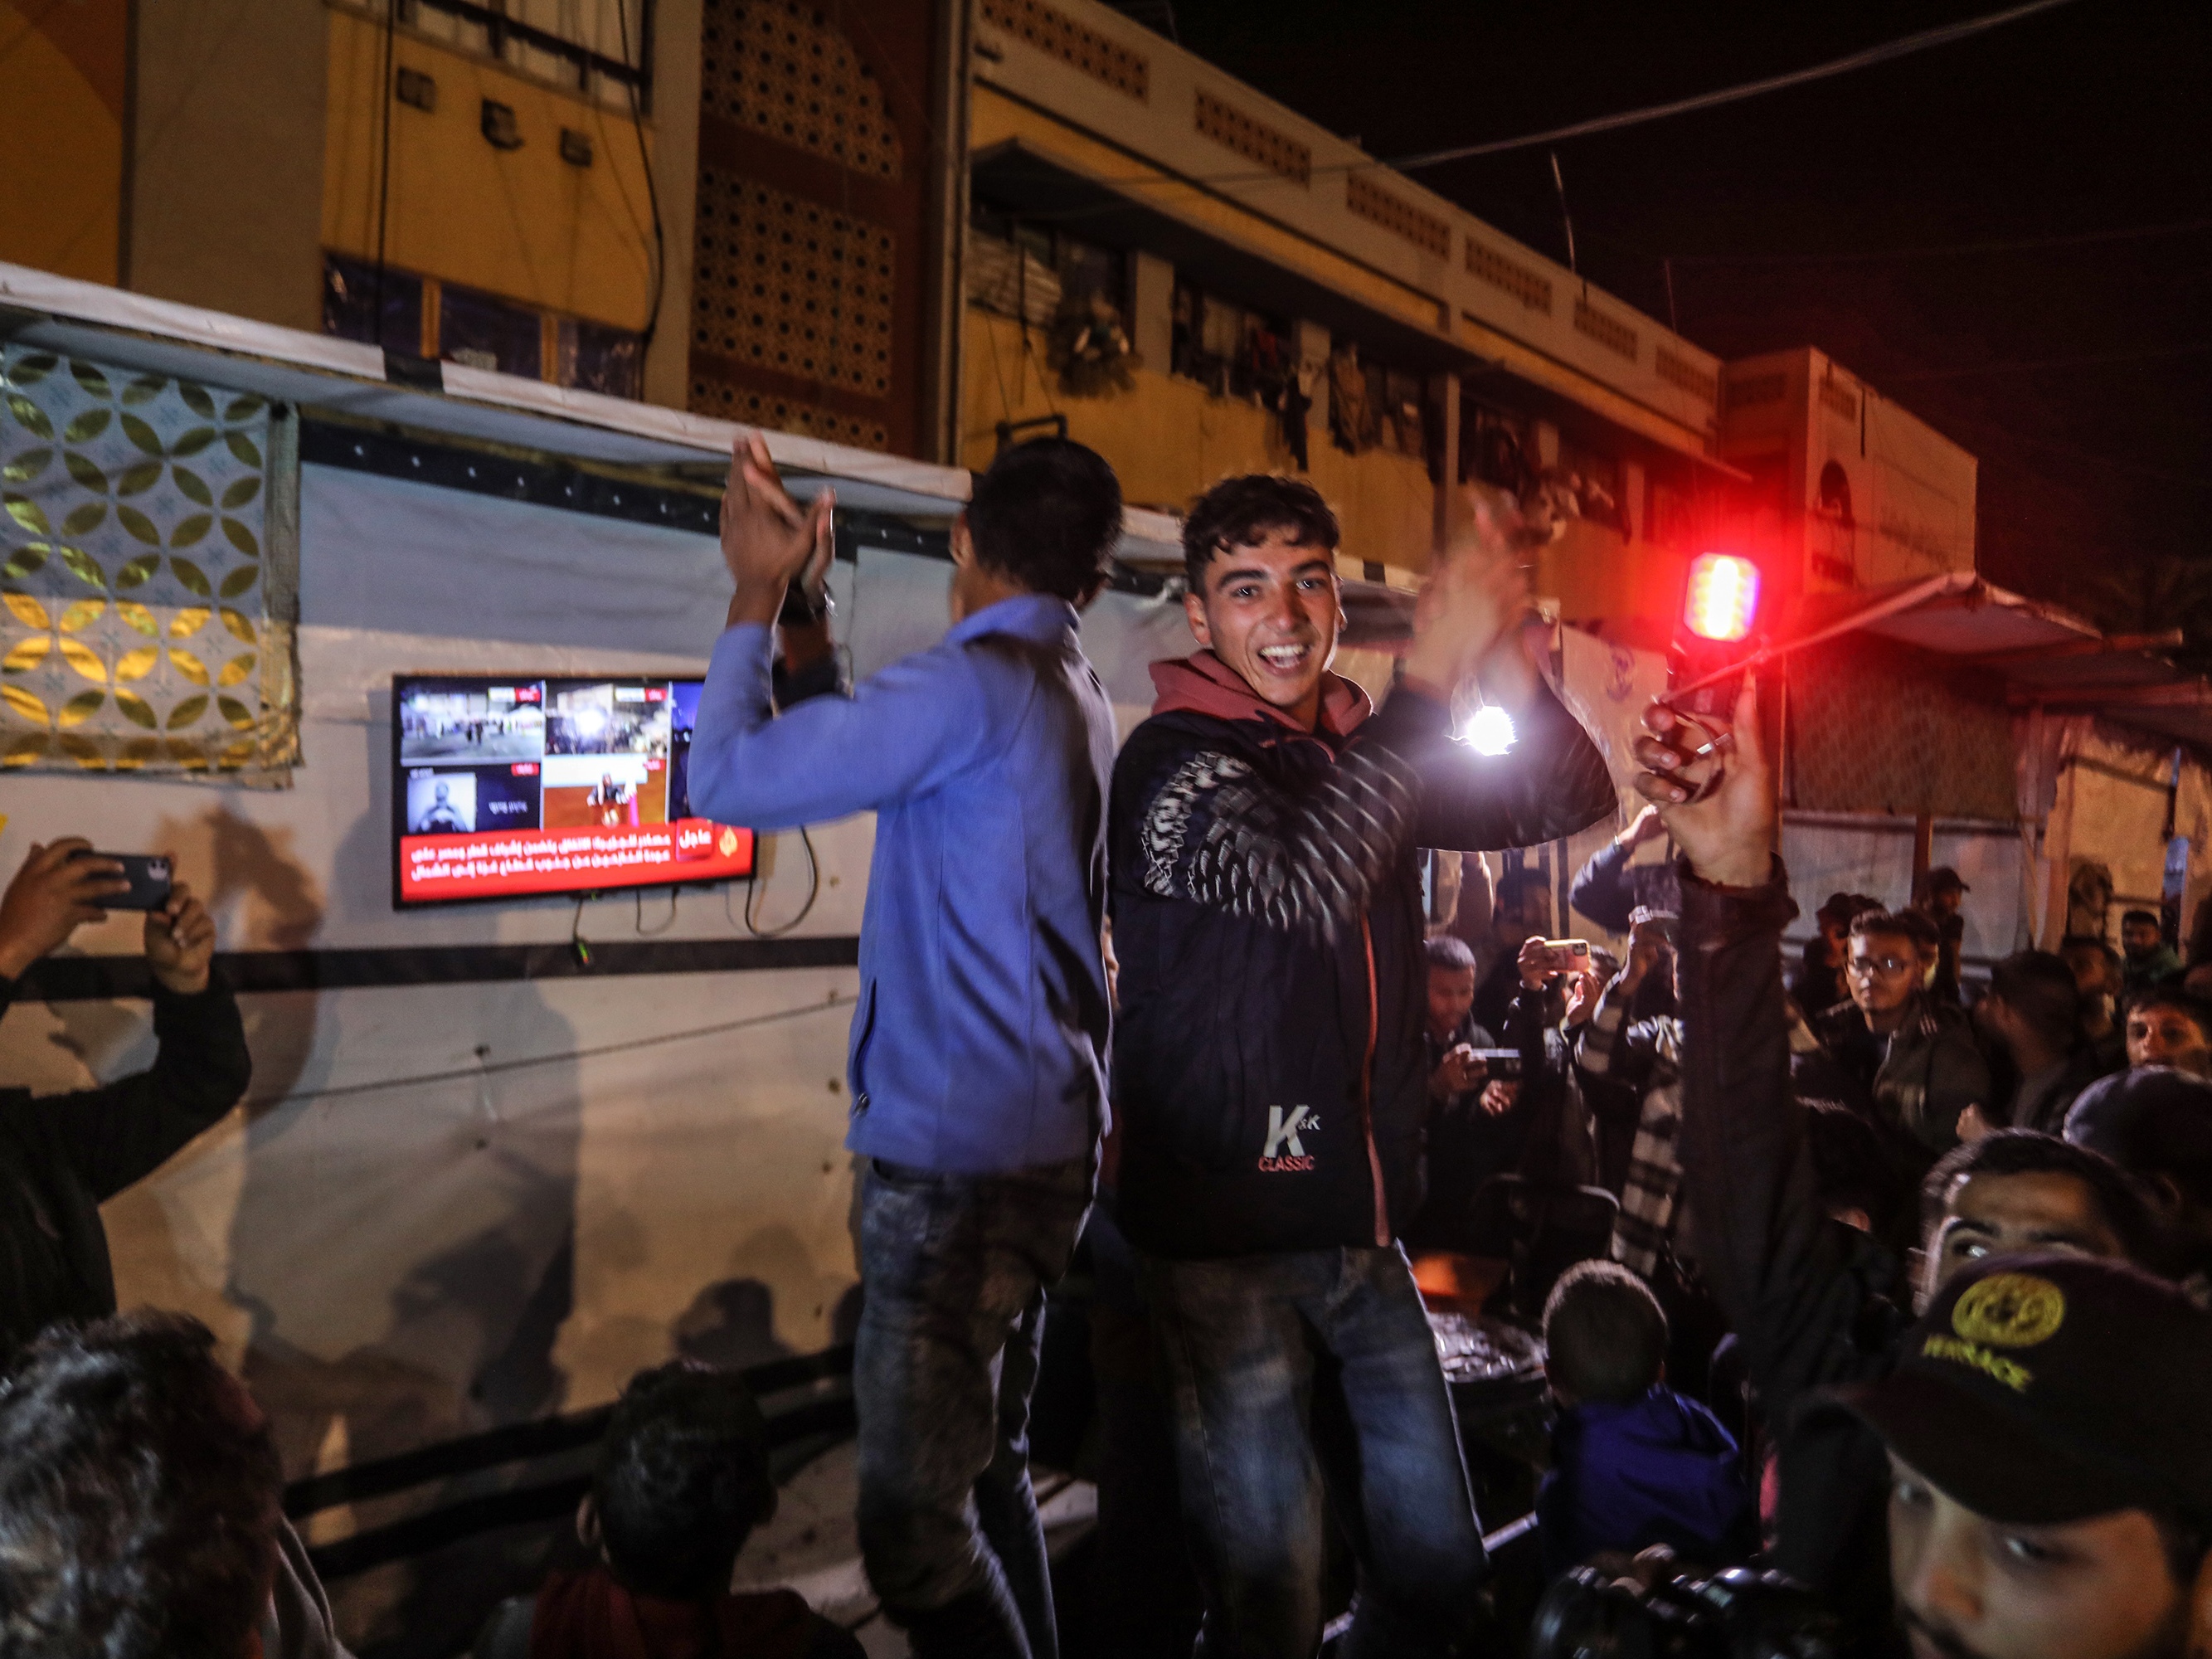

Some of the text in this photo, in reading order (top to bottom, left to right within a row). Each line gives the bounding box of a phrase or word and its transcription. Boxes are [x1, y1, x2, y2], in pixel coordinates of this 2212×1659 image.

[638, 832, 671, 849] مصادر
[678, 828, 712, 849] عاجل
[436, 846, 466, 862] ومصر
[466, 843, 489, 860] قطر
[644, 849, 670, 864] عودة
[451, 860, 476, 879] إلى
[476, 859, 498, 877] غزة
[499, 857, 535, 877] قطاع
[535, 855, 571, 873] جنوب
[571, 853, 591, 870] من
[411, 862, 451, 882] الشمال
[1258, 1155, 1315, 1172] CLASSIC
